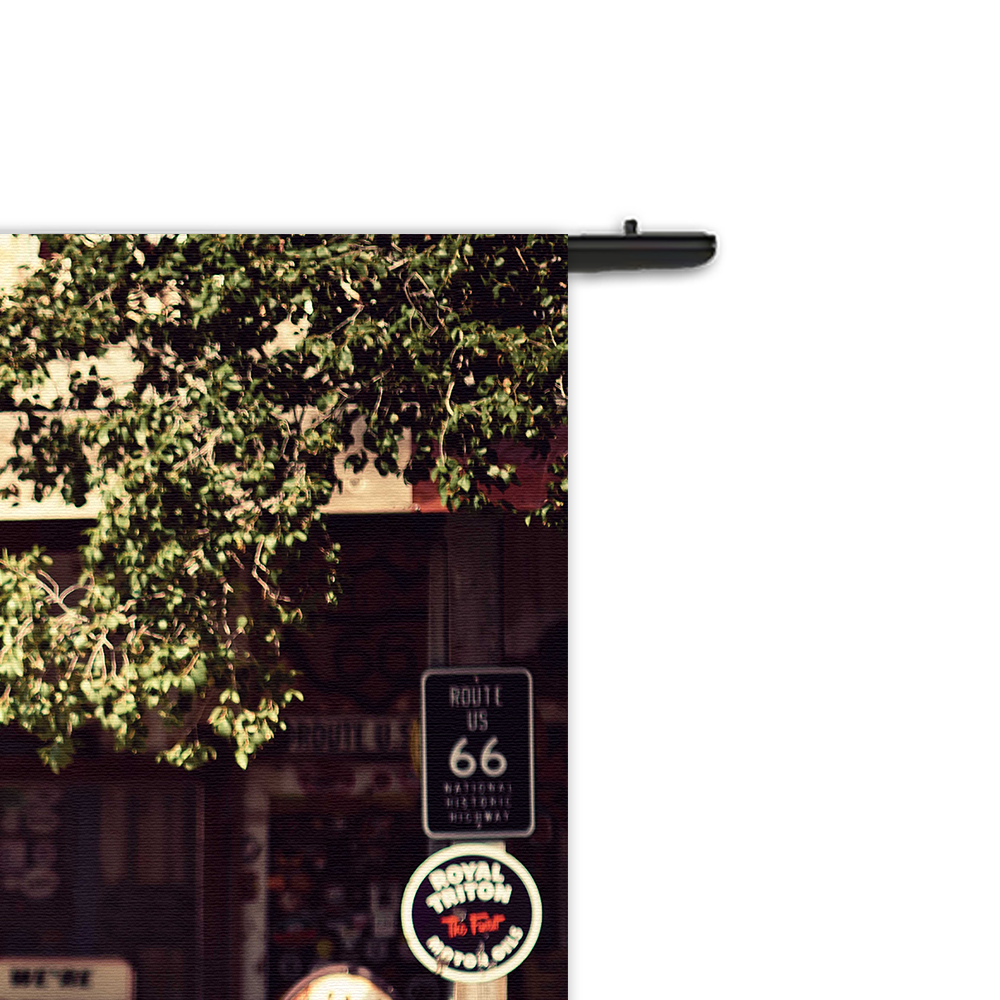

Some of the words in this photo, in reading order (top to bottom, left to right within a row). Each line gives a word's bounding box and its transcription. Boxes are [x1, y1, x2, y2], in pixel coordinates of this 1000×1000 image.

[449, 685, 502, 707] ROUTE
[467, 710, 489, 731] US
[449, 736, 508, 778] 66
[444, 782, 512, 795] NATIONAL
[446, 797, 512, 810] HISTORIC
[449, 811, 509, 823] HIGHWAY
[428, 860, 505, 892] ROYAL
[425, 880, 513, 914] TRITON
[426, 934, 489, 970] MOTOR
[491, 925, 524, 962] OILS
